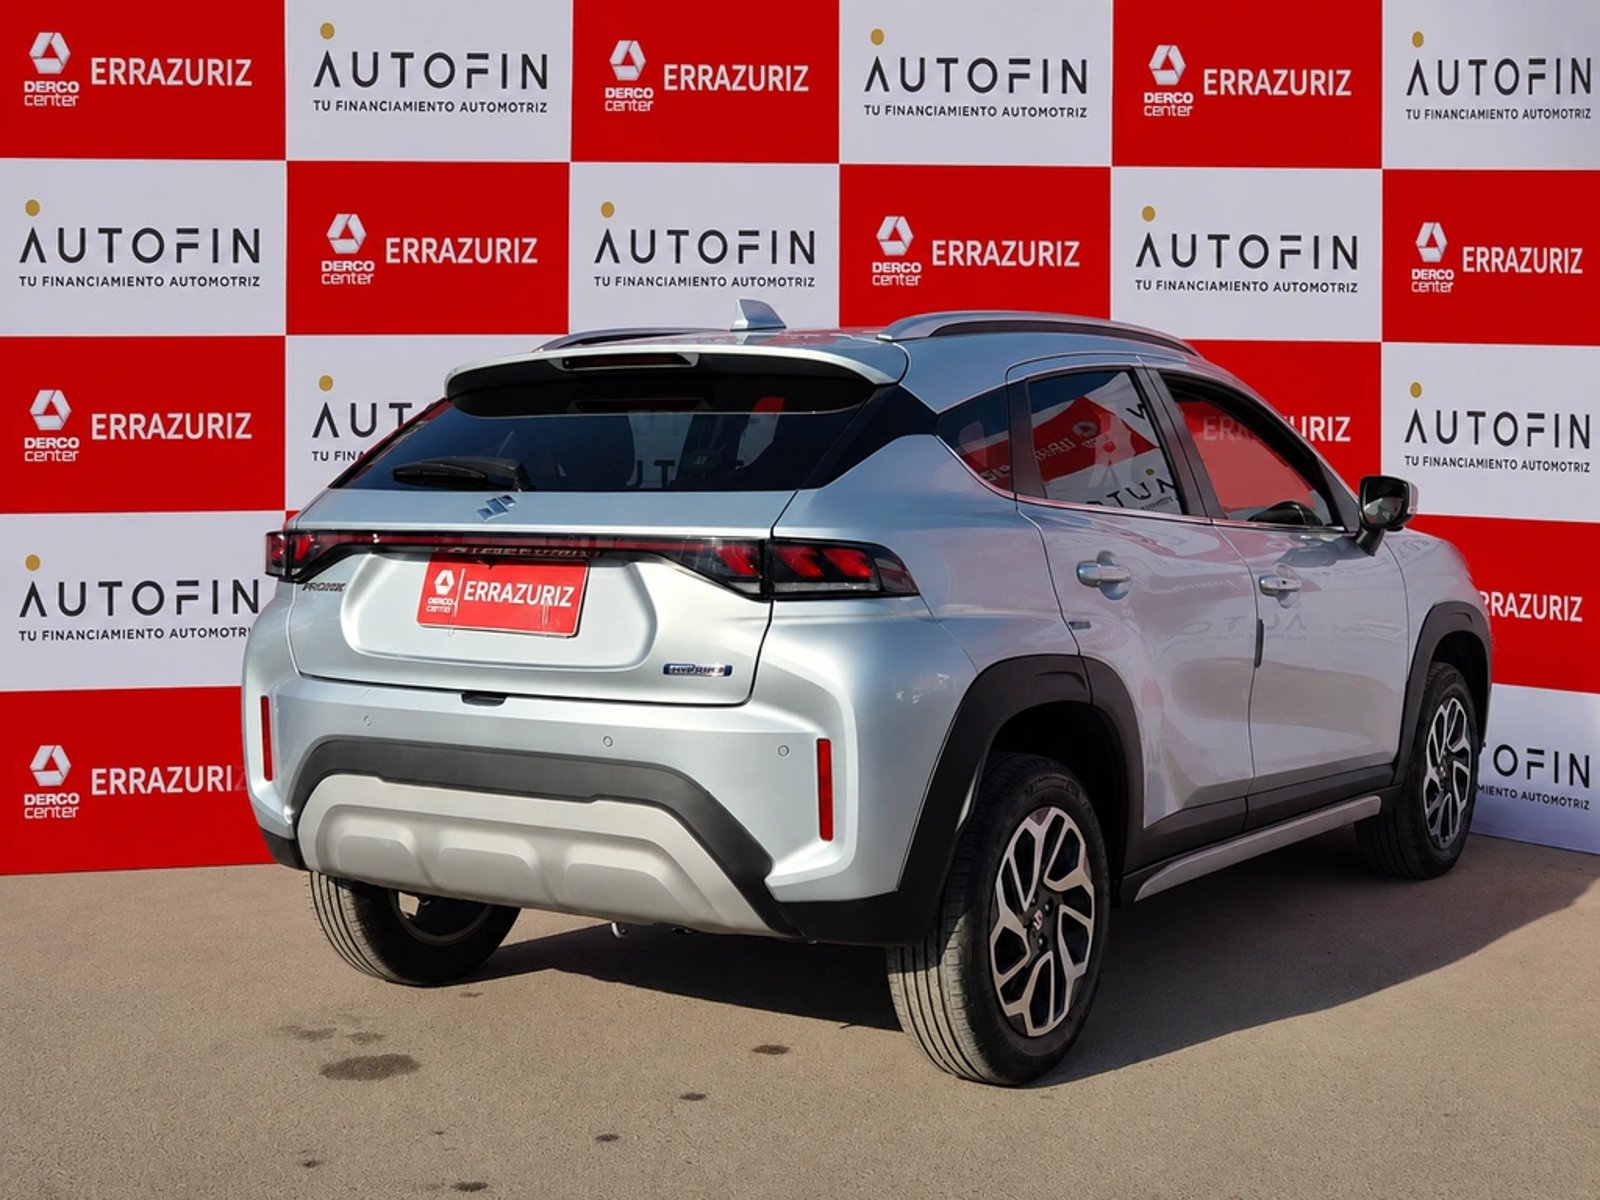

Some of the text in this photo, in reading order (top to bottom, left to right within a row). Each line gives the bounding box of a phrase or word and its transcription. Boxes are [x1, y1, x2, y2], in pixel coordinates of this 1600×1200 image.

[92, 58, 252, 86] ERRAZURIZ
[314, 50, 547, 89] AUTOFIN
[864, 56, 1087, 94] AUTOFIN
[664, 64, 808, 91] ERRAZURIZ
[1204, 69, 1351, 95] ERRAZURIZ
[1406, 57, 1591, 96] AUTOFIN
[24, 81, 79, 93] DERCO
[605, 87, 653, 99] DERCO
[25, 94, 78, 106] center
[1144, 92, 1193, 104] DERCO
[313, 100, 547, 113] TU FINANCIAMIENTO AUTOMOTRIZ
[605, 99, 653, 111] center
[864, 105, 1087, 118] TU FINANCIAMIENTO AUTOMOTRIZ
[1144, 104, 1192, 116] center
[1406, 108, 1591, 120] TU FINANCIAMIENTO AUTOMOTRIZ
[19, 227, 259, 263] AUTOFIN
[386, 238, 537, 263] ERRAZURIZ
[594, 229, 814, 264] AUTOFIN
[1136, 232, 1357, 270] AUTOFIN
[933, 240, 1080, 266] ERRAZURIZ
[322, 261, 375, 272] DERCO
[1463, 247, 1582, 273] ERRAZURIZ
[872, 262, 921, 273] DERCO
[322, 272, 373, 284] center
[873, 273, 921, 286] center
[1412, 269, 1454, 280] DERCO
[19, 276, 260, 287] TU FINANCIAMIENTO AUTOMOTRIZ
[594, 276, 814, 287] TU FINANCIAMIENTO AUTOMOTRIZ
[1135, 280, 1358, 293] TU FINANCIAMIENTO AUTOMOTRIZ
[1412, 280, 1453, 292] center
[92, 413, 252, 440] ERRAZURIZ
[1405, 409, 1590, 449] AUTOFIN
[25, 437, 79, 449] DERCO
[25, 449, 79, 461] center
[312, 451, 329, 461] TU
[1405, 456, 1590, 472] TU FINANCIAMIENTO AUTOMOTRIZ
[19, 580, 258, 617] AUTOFIN
[463, 581, 575, 607] ERRAZURIZ
[19, 627, 250, 641] TU FINANCIAMIENTO AUTOMOTR
[1493, 744, 1590, 788] OFIN
[24, 793, 79, 806] DERCO
[1521, 791, 1590, 810] AUTOMOTRIZ
[25, 806, 78, 819] center
